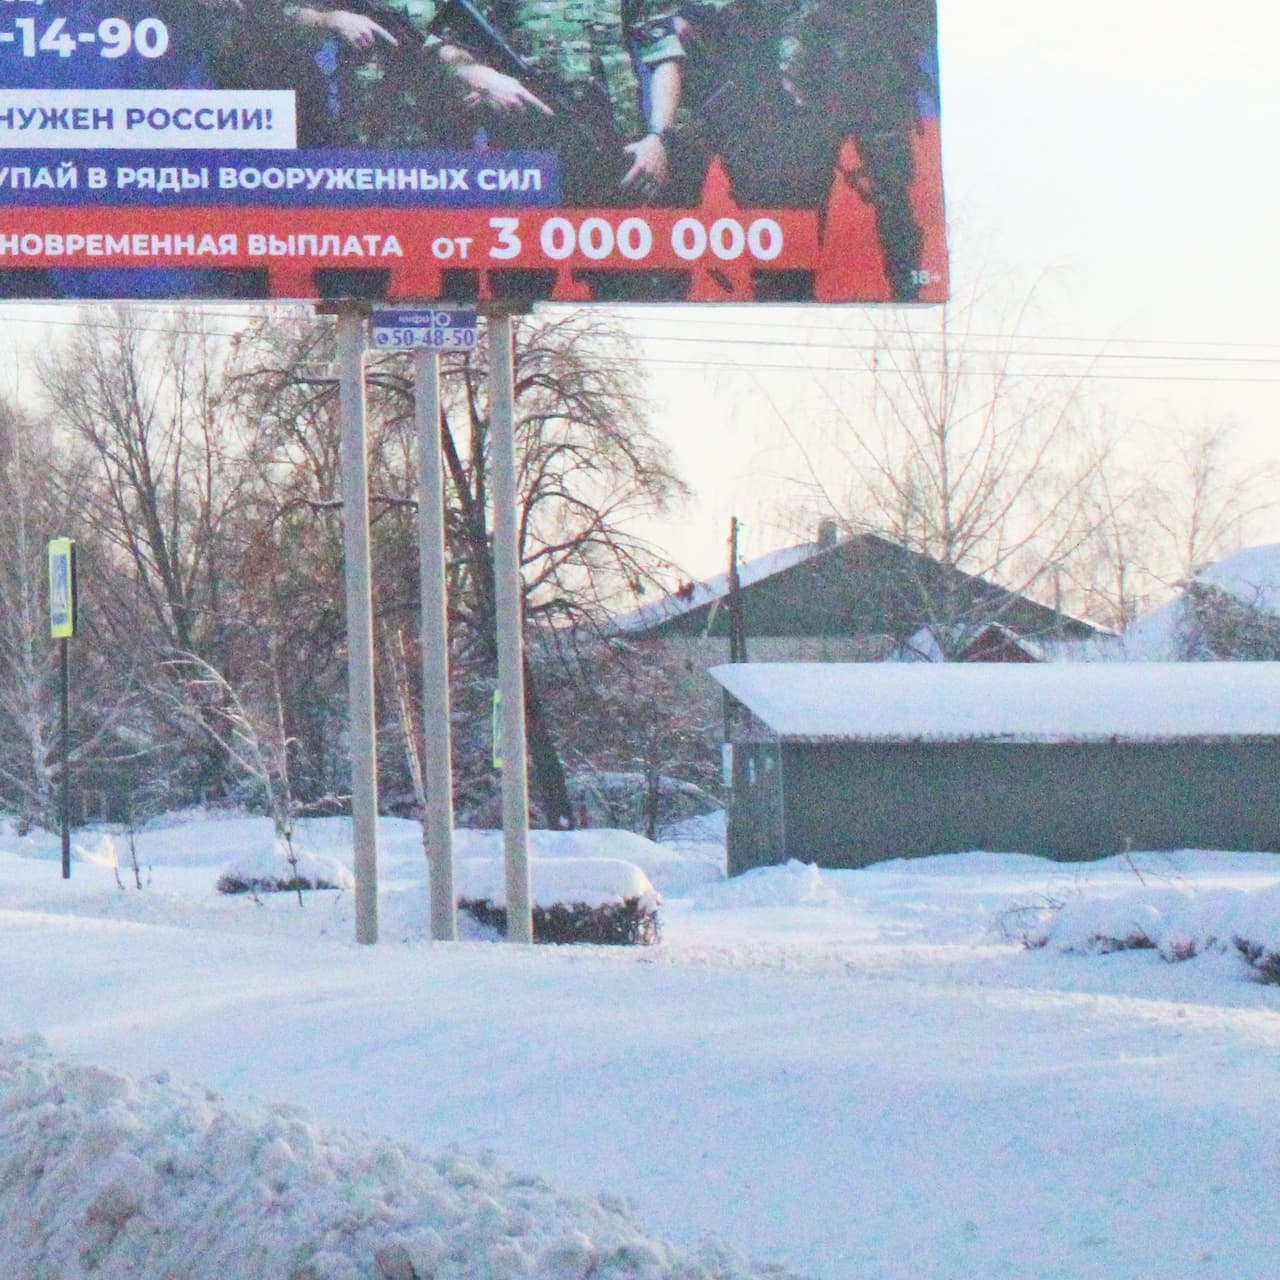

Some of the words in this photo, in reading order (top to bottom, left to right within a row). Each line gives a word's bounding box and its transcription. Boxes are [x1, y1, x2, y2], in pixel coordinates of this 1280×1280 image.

[126, 107, 274, 131] РОССИИ!
[87, 169, 107, 189] В
[117, 169, 209, 193] РЯДЫ
[219, 168, 468, 191] ВООРУЖЕННЫХ
[477, 169, 542, 191] СИЛ
[248, 234, 404, 257] ВЫПЛАТА
[489, 218, 522, 259] 3
[540, 218, 653, 260] 000
[670, 218, 784, 260] 000
[392, 329, 474, 346] 50-48-50
